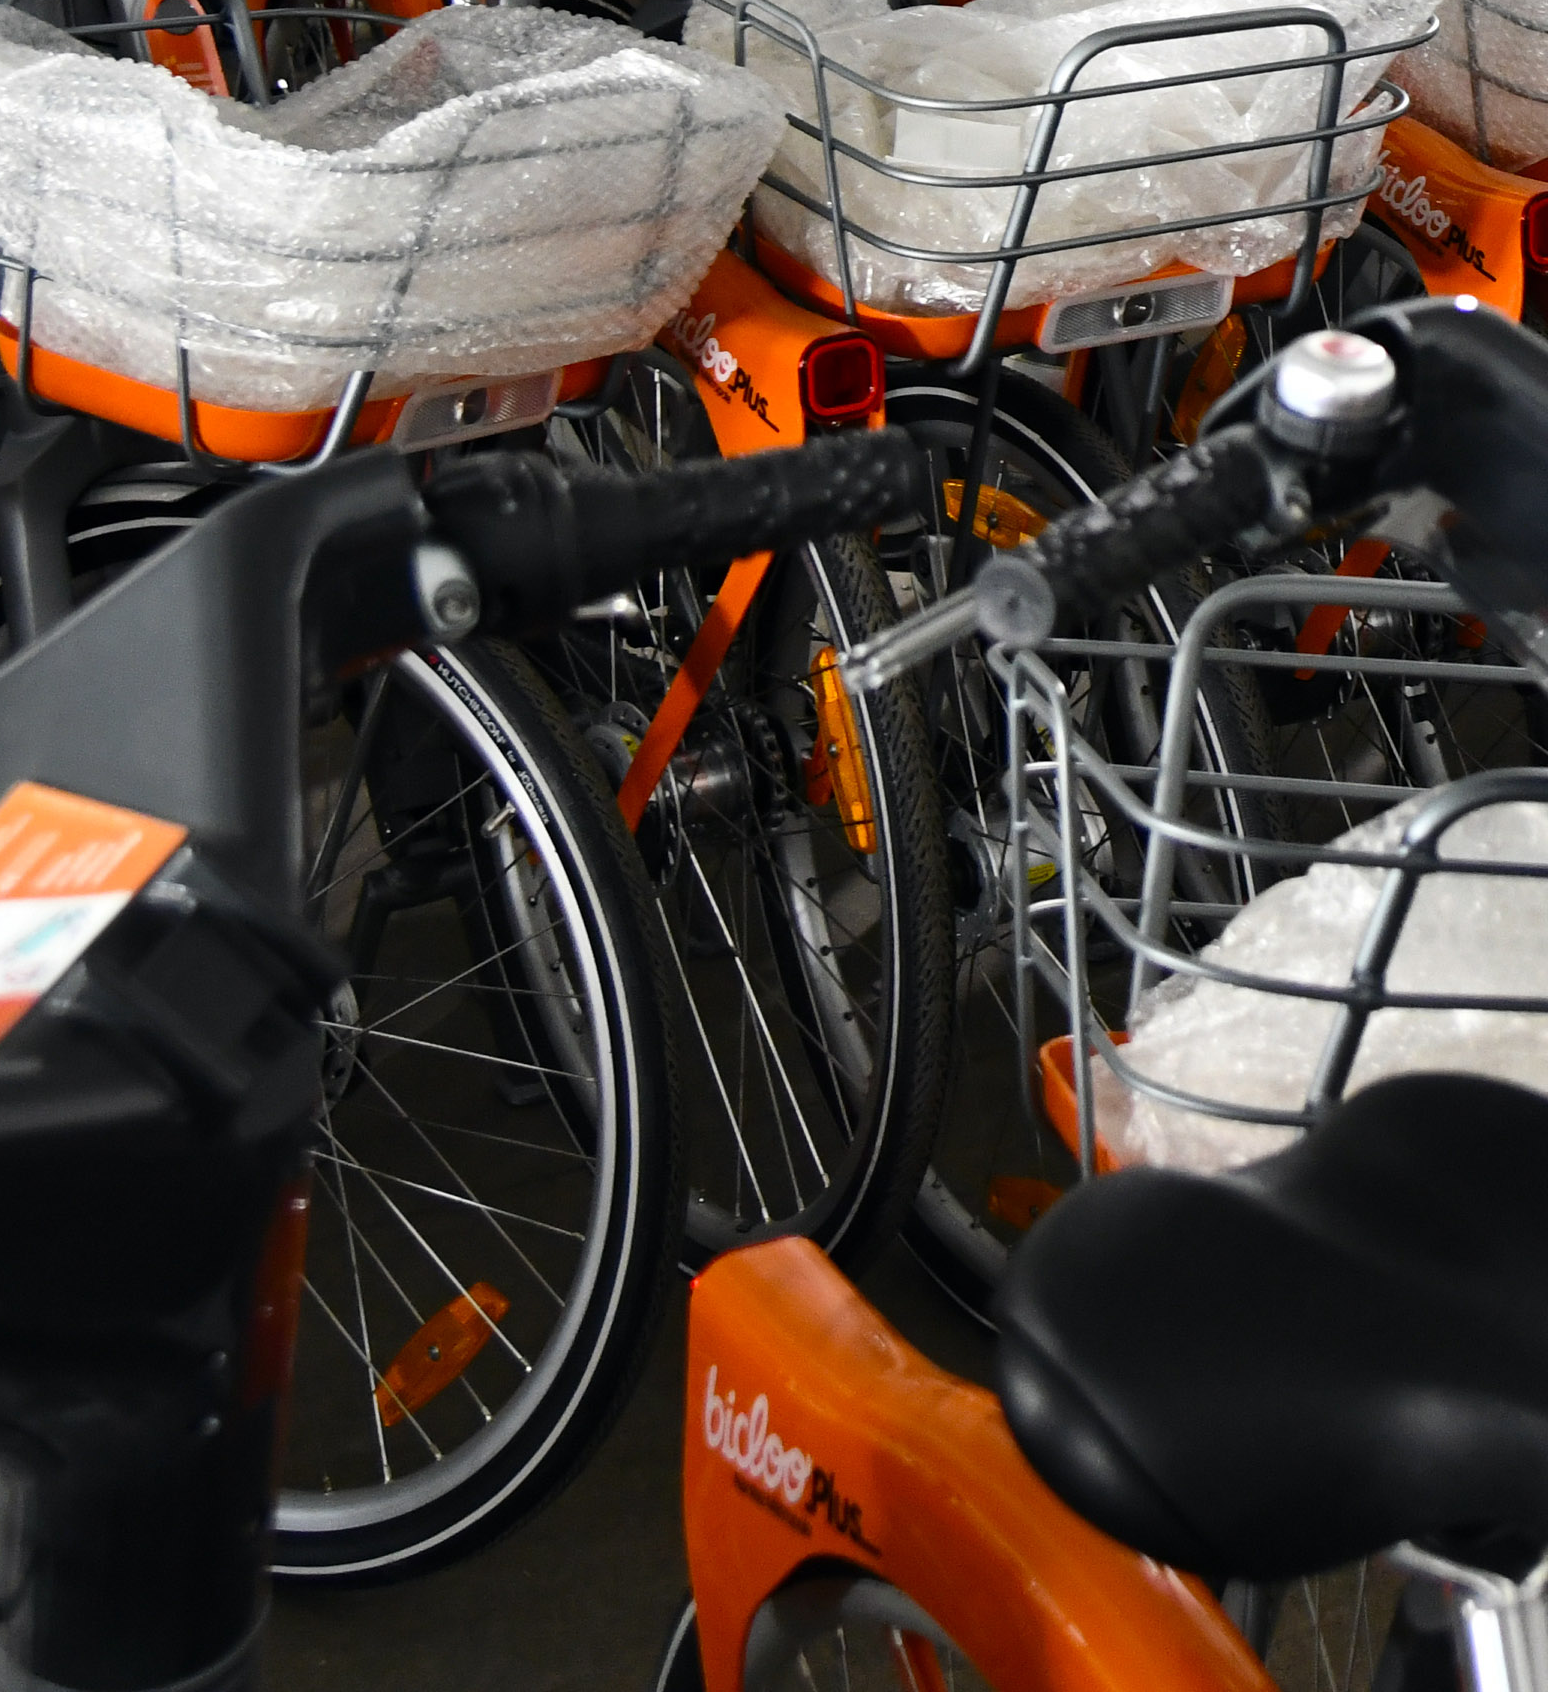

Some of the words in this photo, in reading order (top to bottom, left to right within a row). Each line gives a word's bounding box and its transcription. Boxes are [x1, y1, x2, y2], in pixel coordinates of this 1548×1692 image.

[1441, 224, 1497, 283] Plus
[667, 310, 738, 382] icloo
[728, 367, 780, 433] Plus
[437, 662, 505, 745] HUTCHINSON
[705, 1364, 813, 1504] bicloo
[805, 1467, 882, 1558] Plus
